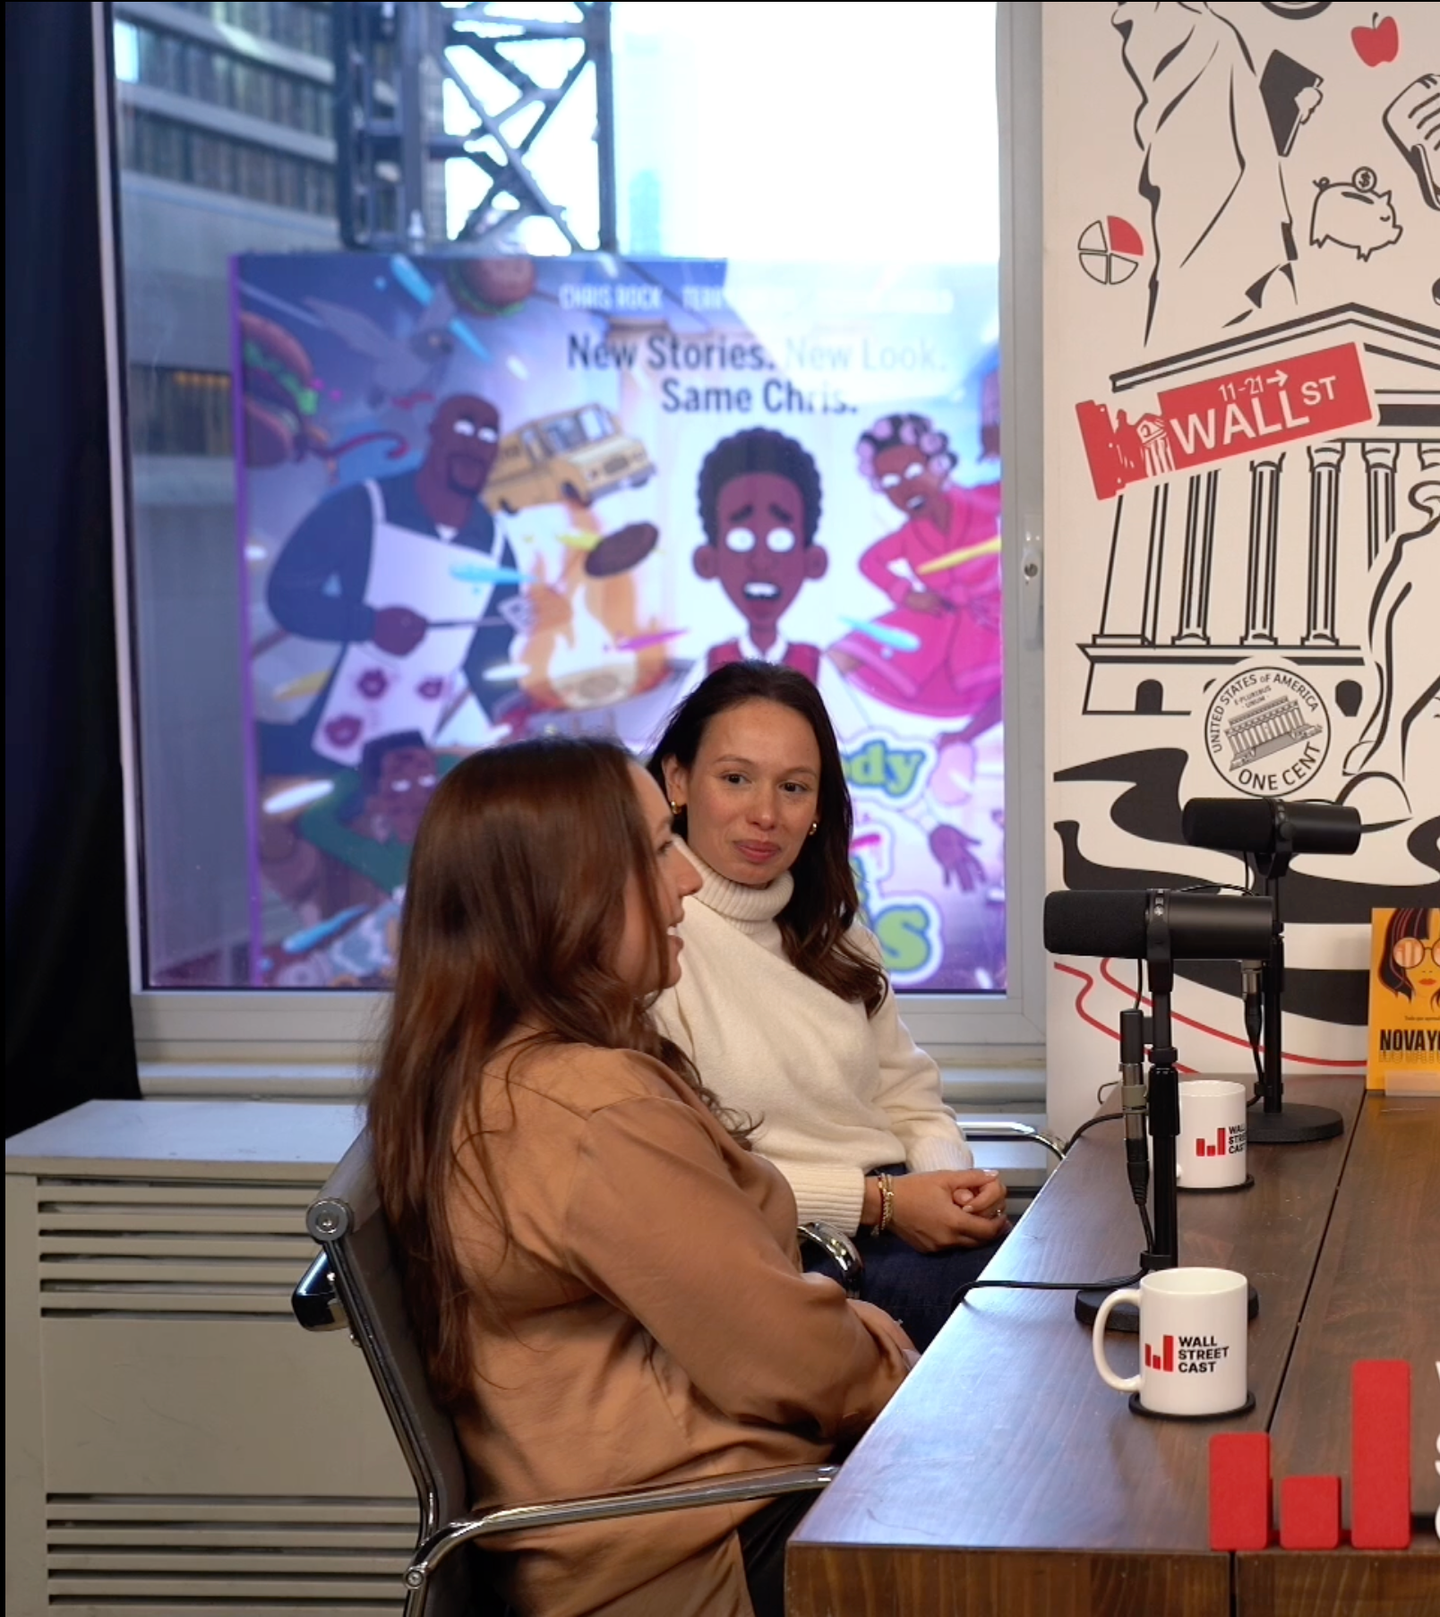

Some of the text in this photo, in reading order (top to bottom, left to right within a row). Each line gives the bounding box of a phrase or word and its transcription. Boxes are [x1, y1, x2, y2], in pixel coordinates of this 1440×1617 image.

[568, 334, 948, 372] New Stories. New Look.
[662, 377, 859, 415] Same Chris.
[1218, 374, 1265, 403] 11-21
[1169, 375, 1338, 455] WALL ST
[1210, 705, 1225, 754] UNITED
[1220, 674, 1257, 705] STATES
[1273, 673, 1319, 712] AMERICA
[1238, 741, 1320, 791] ONE CENT
[1178, 1335, 1217, 1347] WALL
[1178, 1346, 1229, 1360] STREET
[1178, 1361, 1217, 1373] CAST
